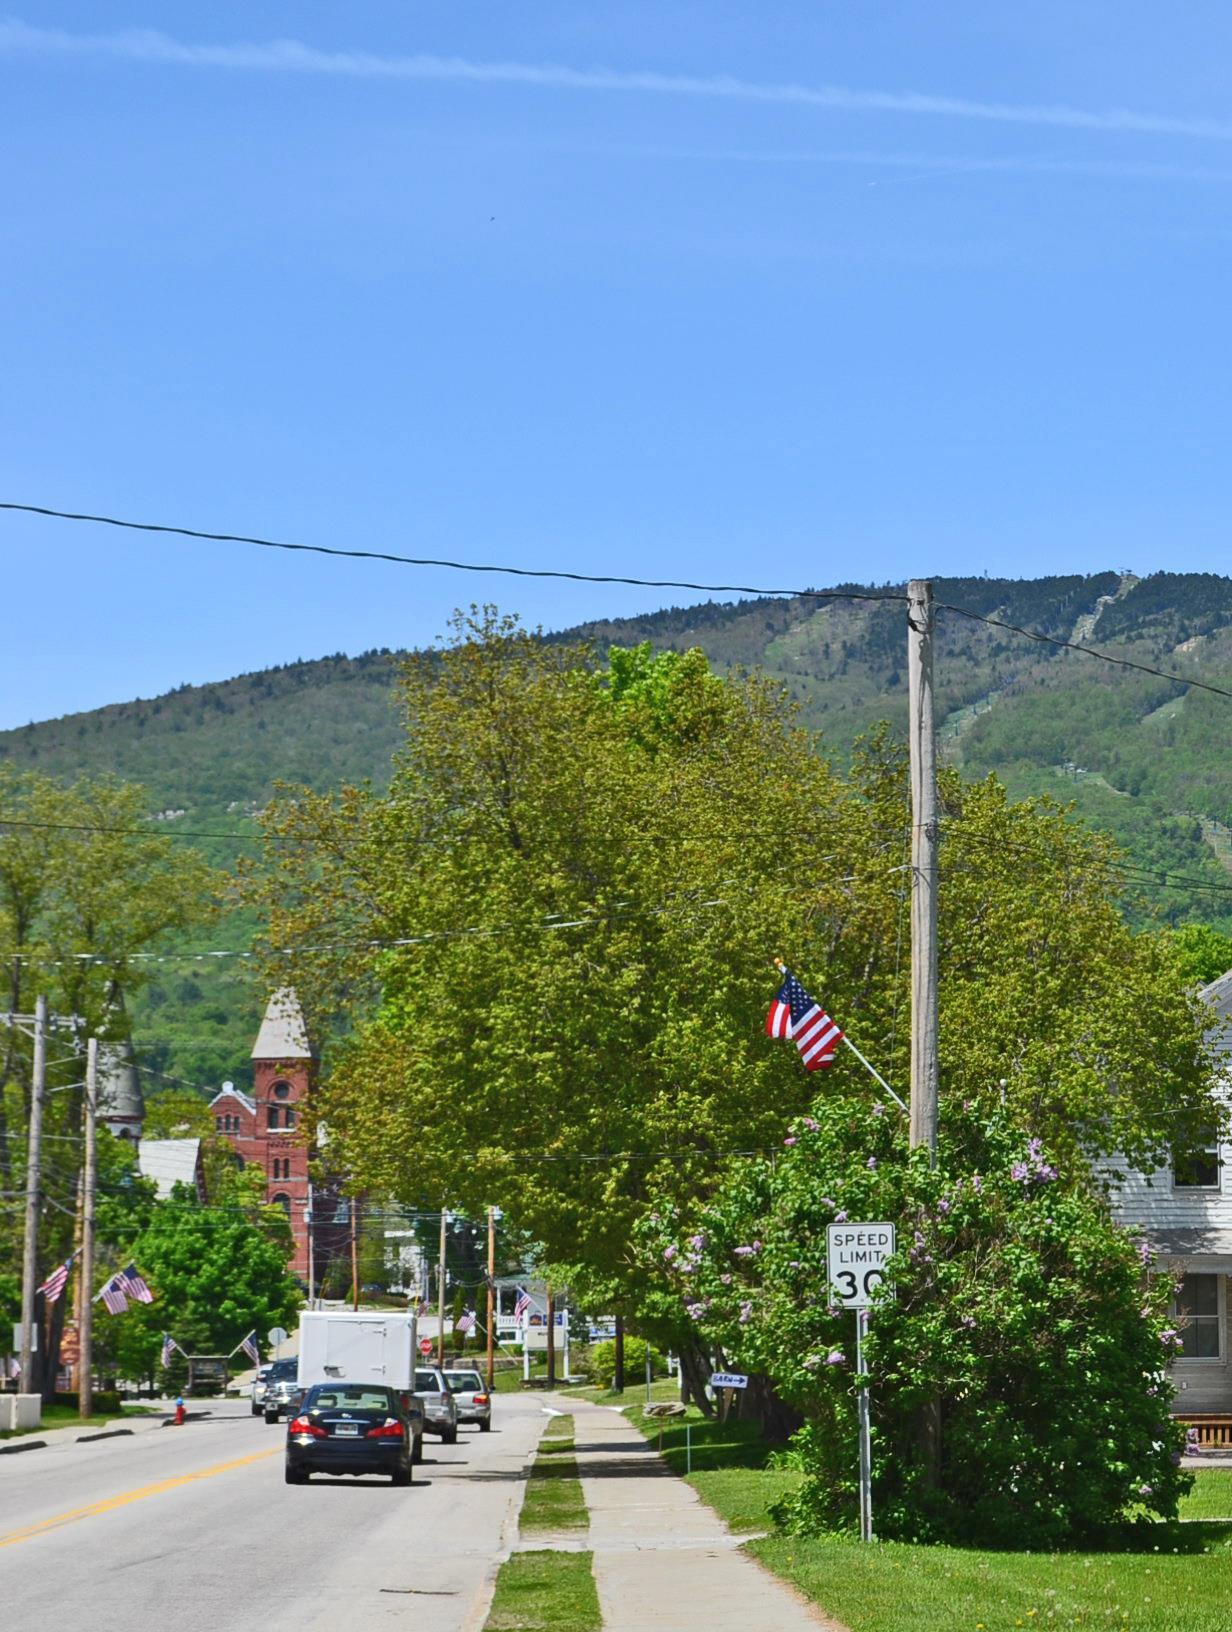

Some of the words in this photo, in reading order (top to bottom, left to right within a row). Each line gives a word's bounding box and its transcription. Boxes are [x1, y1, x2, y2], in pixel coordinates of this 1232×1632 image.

[834, 1233, 889, 1247] SPEED
[840, 1250, 882, 1264] LIMIT
[836, 1269, 887, 1300] 30
